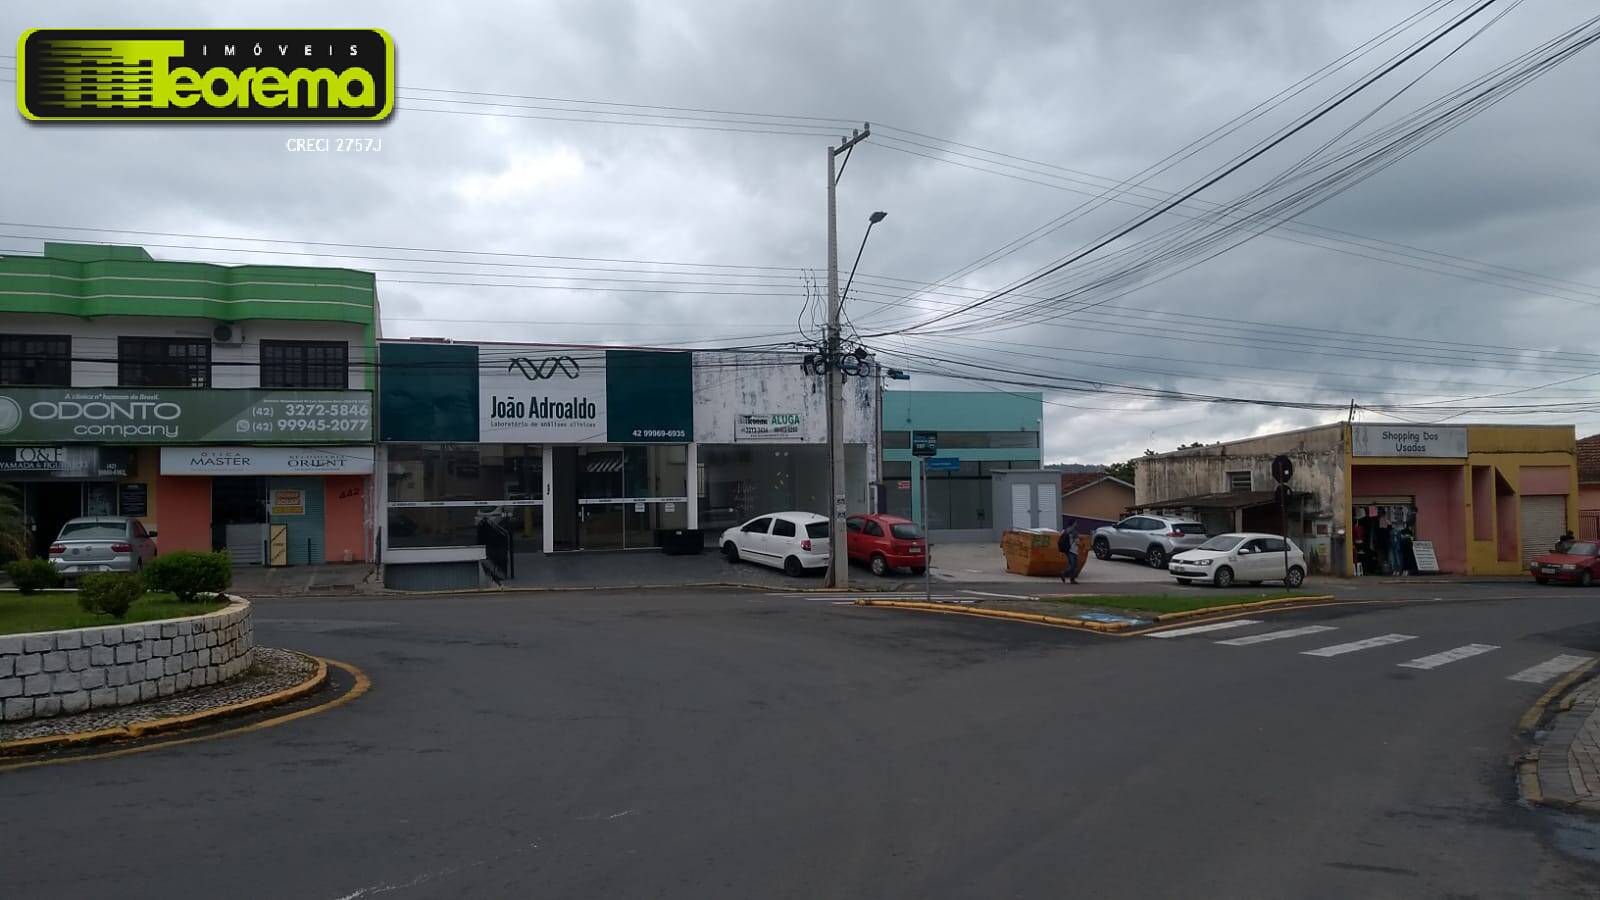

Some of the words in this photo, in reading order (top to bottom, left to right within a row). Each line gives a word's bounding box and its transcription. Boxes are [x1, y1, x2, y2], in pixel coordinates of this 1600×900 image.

[29, 402, 182, 420] ODONTO
[252, 407, 274, 417] (42)
[285, 404, 369, 416] 3272-5846
[490, 396, 525, 419] João
[528, 397, 596, 420] Adroaldo
[252, 422, 273, 432] (42)
[277, 419, 369, 432] 99945-2077
[771, 415, 800, 425] ALUGA
[73, 424, 179, 438] company
[632, 429, 642, 437] 42
[1382, 431, 1420, 443] Shopping
[1423, 431, 1439, 441] Dos
[1395, 443, 1427, 453] Usados
[190, 457, 251, 466] MASTER
[287, 459, 348, 468] ORIENT
